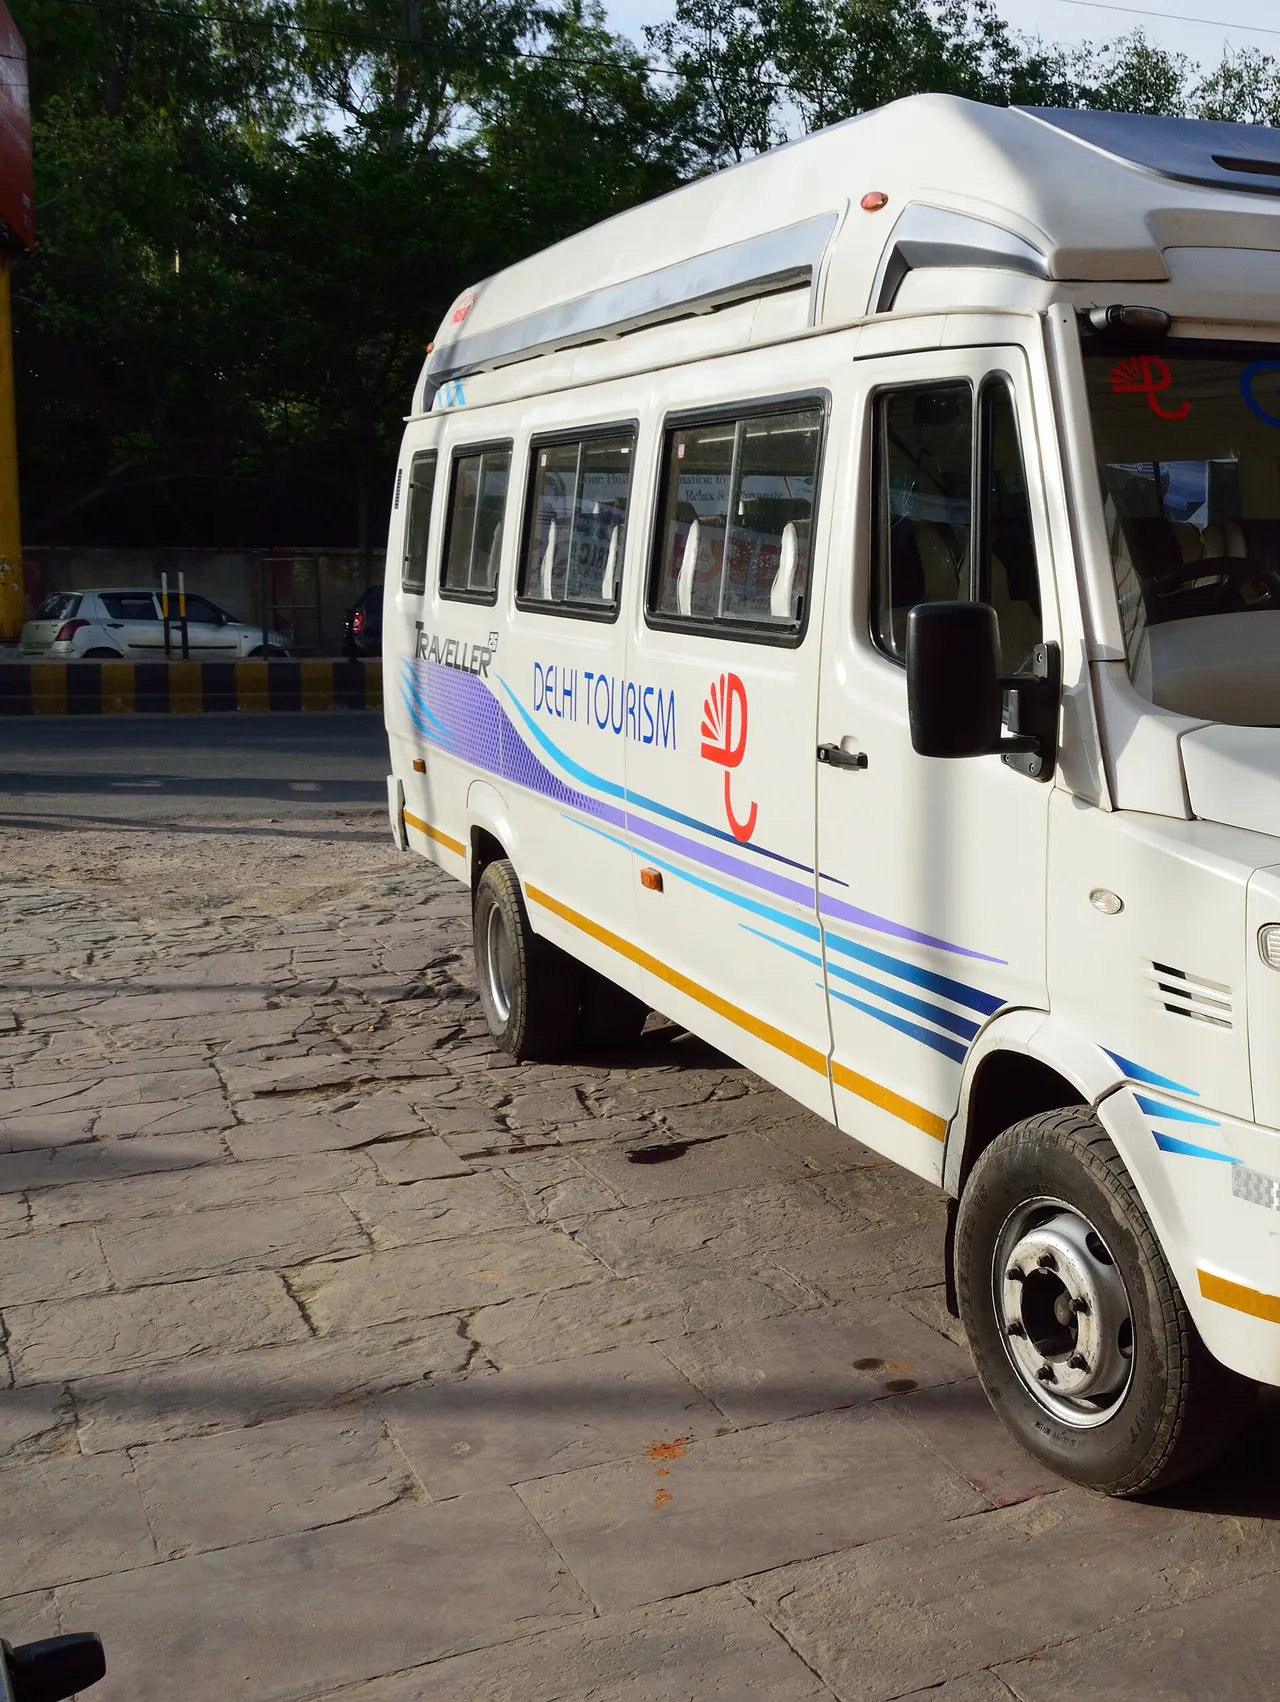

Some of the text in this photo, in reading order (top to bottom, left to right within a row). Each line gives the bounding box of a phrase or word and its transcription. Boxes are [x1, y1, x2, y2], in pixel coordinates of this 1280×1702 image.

[685, 489, 715, 501] Relax
[533, 661, 677, 751] DELHI TOURISM
